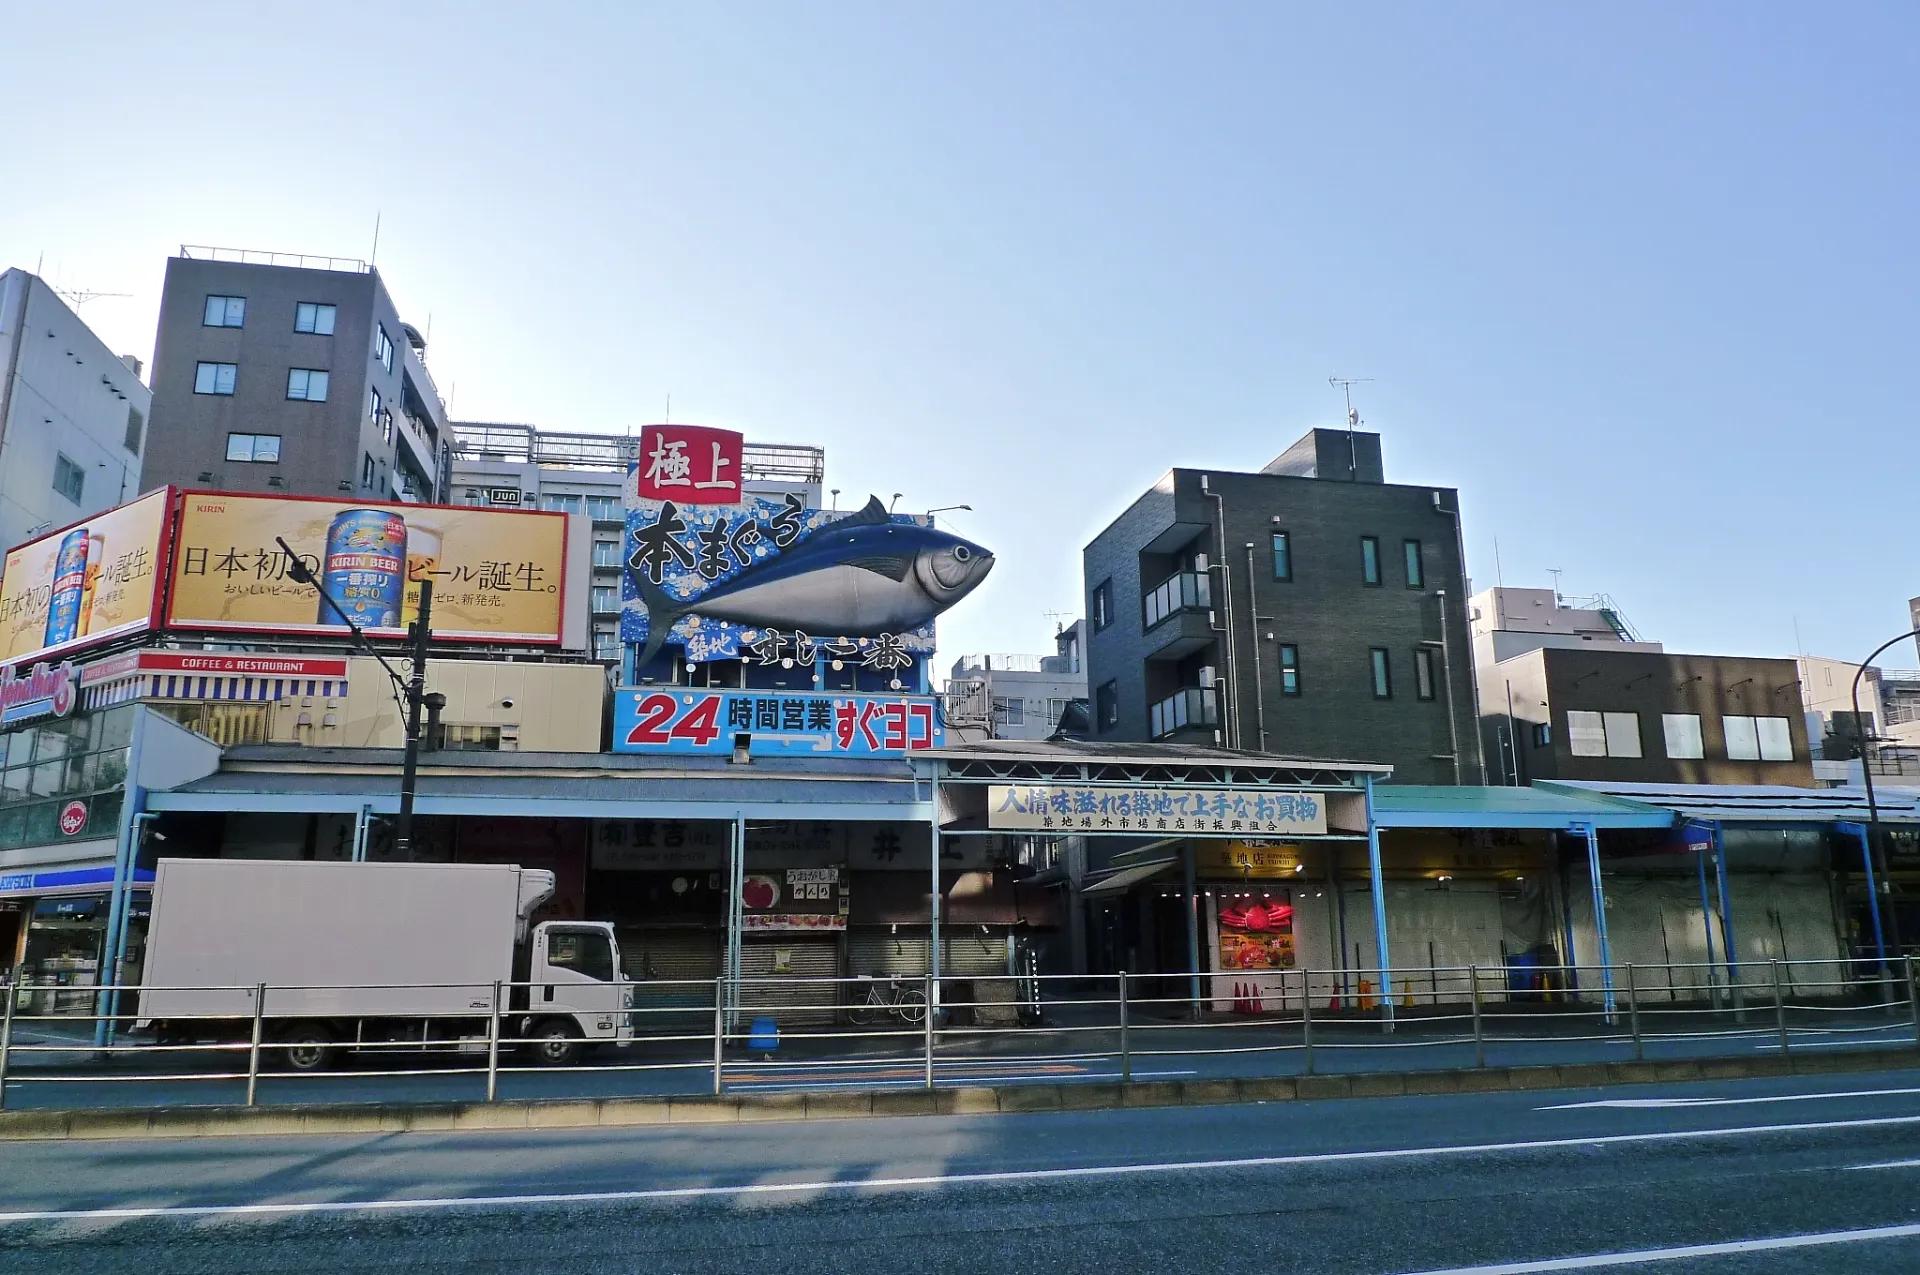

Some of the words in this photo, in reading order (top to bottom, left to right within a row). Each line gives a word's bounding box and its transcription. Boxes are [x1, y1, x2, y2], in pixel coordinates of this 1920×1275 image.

[645, 433, 736, 489] 極上
[495, 489, 516, 501] JUN
[196, 505, 225, 514] KIRIN
[629, 493, 801, 584] 本まぐろ
[184, 547, 320, 581] 日本初の
[408, 558, 557, 594] ビール誕生。
[331, 557, 366, 568] KIRIN
[370, 558, 398, 571] BEER
[336, 573, 388, 588] 一番搾り
[407, 591, 506, 608] 糖ゼロ、新発売。
[687, 632, 737, 661] 築地
[751, 628, 912, 669] すし一番
[182, 658, 220, 669] COFFEE
[225, 660, 233, 669] &
[237, 660, 304, 671] RESTAURANT
[626, 693, 831, 745] 24時間営業
[835, 700, 933, 752] すぐヨコ
[997, 787, 1318, 822] 人情味溢れる築地で上手なお買物
[1043, 816, 1278, 832] 築地場外市場商店街振興組合
